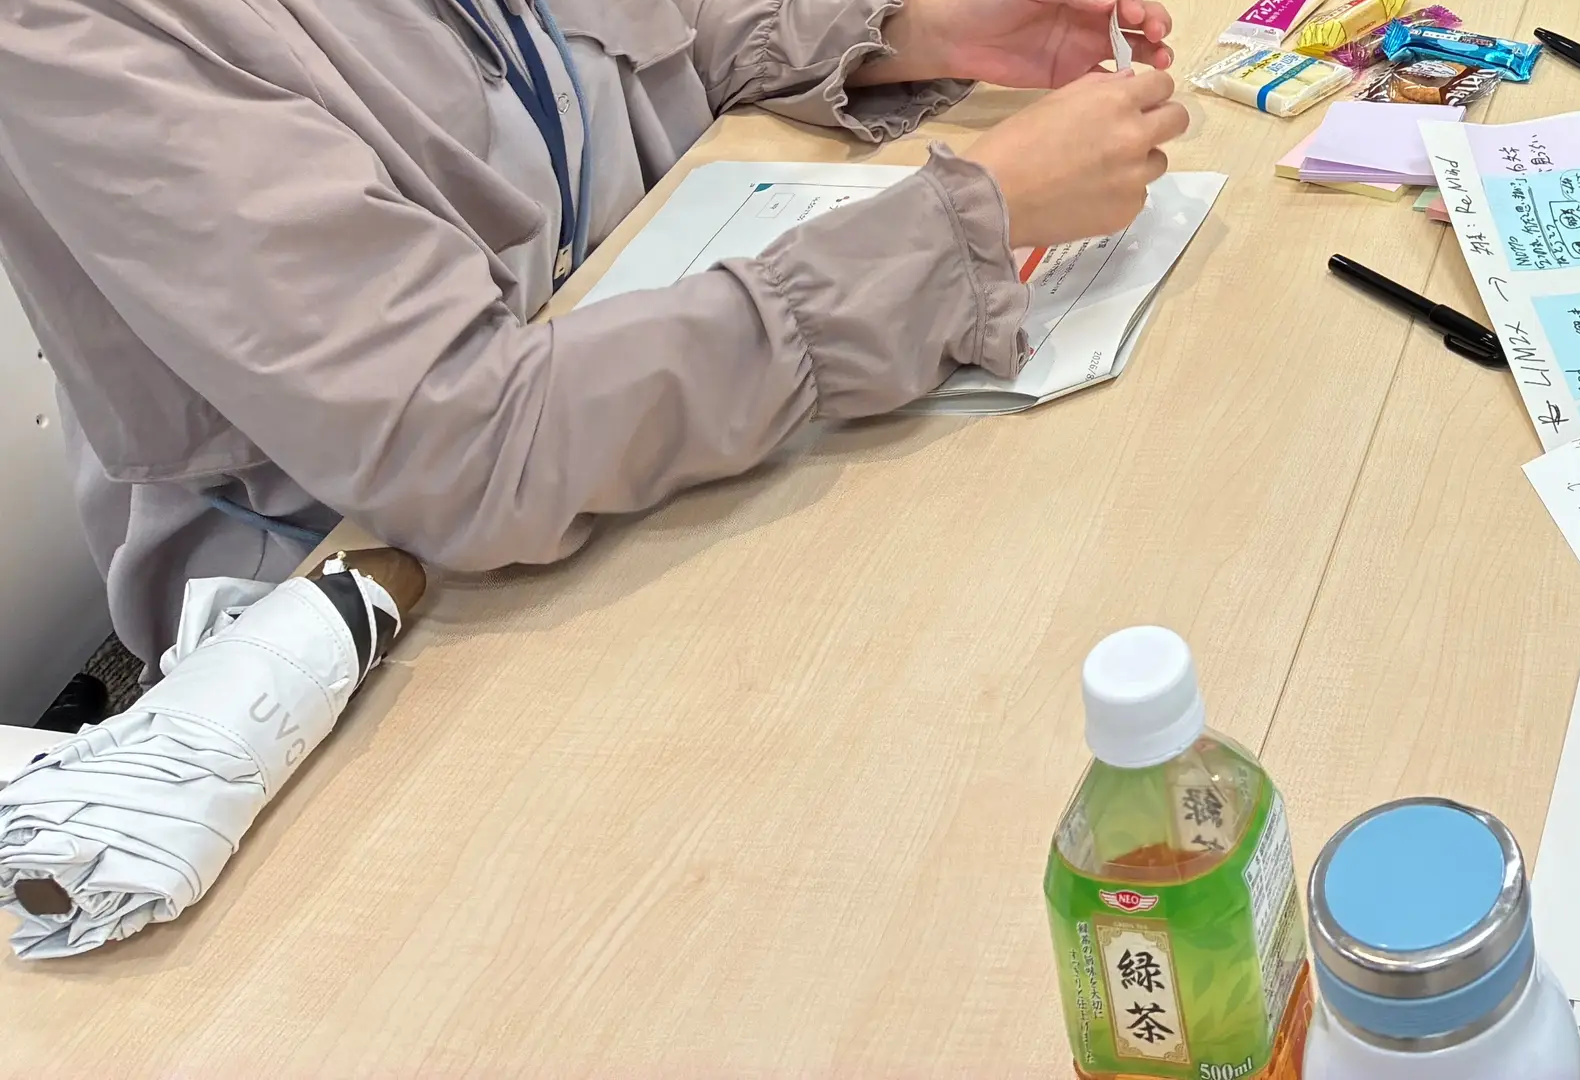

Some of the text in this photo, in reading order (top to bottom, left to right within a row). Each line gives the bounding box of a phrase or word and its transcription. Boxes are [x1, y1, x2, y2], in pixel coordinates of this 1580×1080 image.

[1118, 894, 1139, 905] NEO
[1117, 949, 1174, 1043] 緑茶
[1199, 1058, 1253, 1080] 500ml
